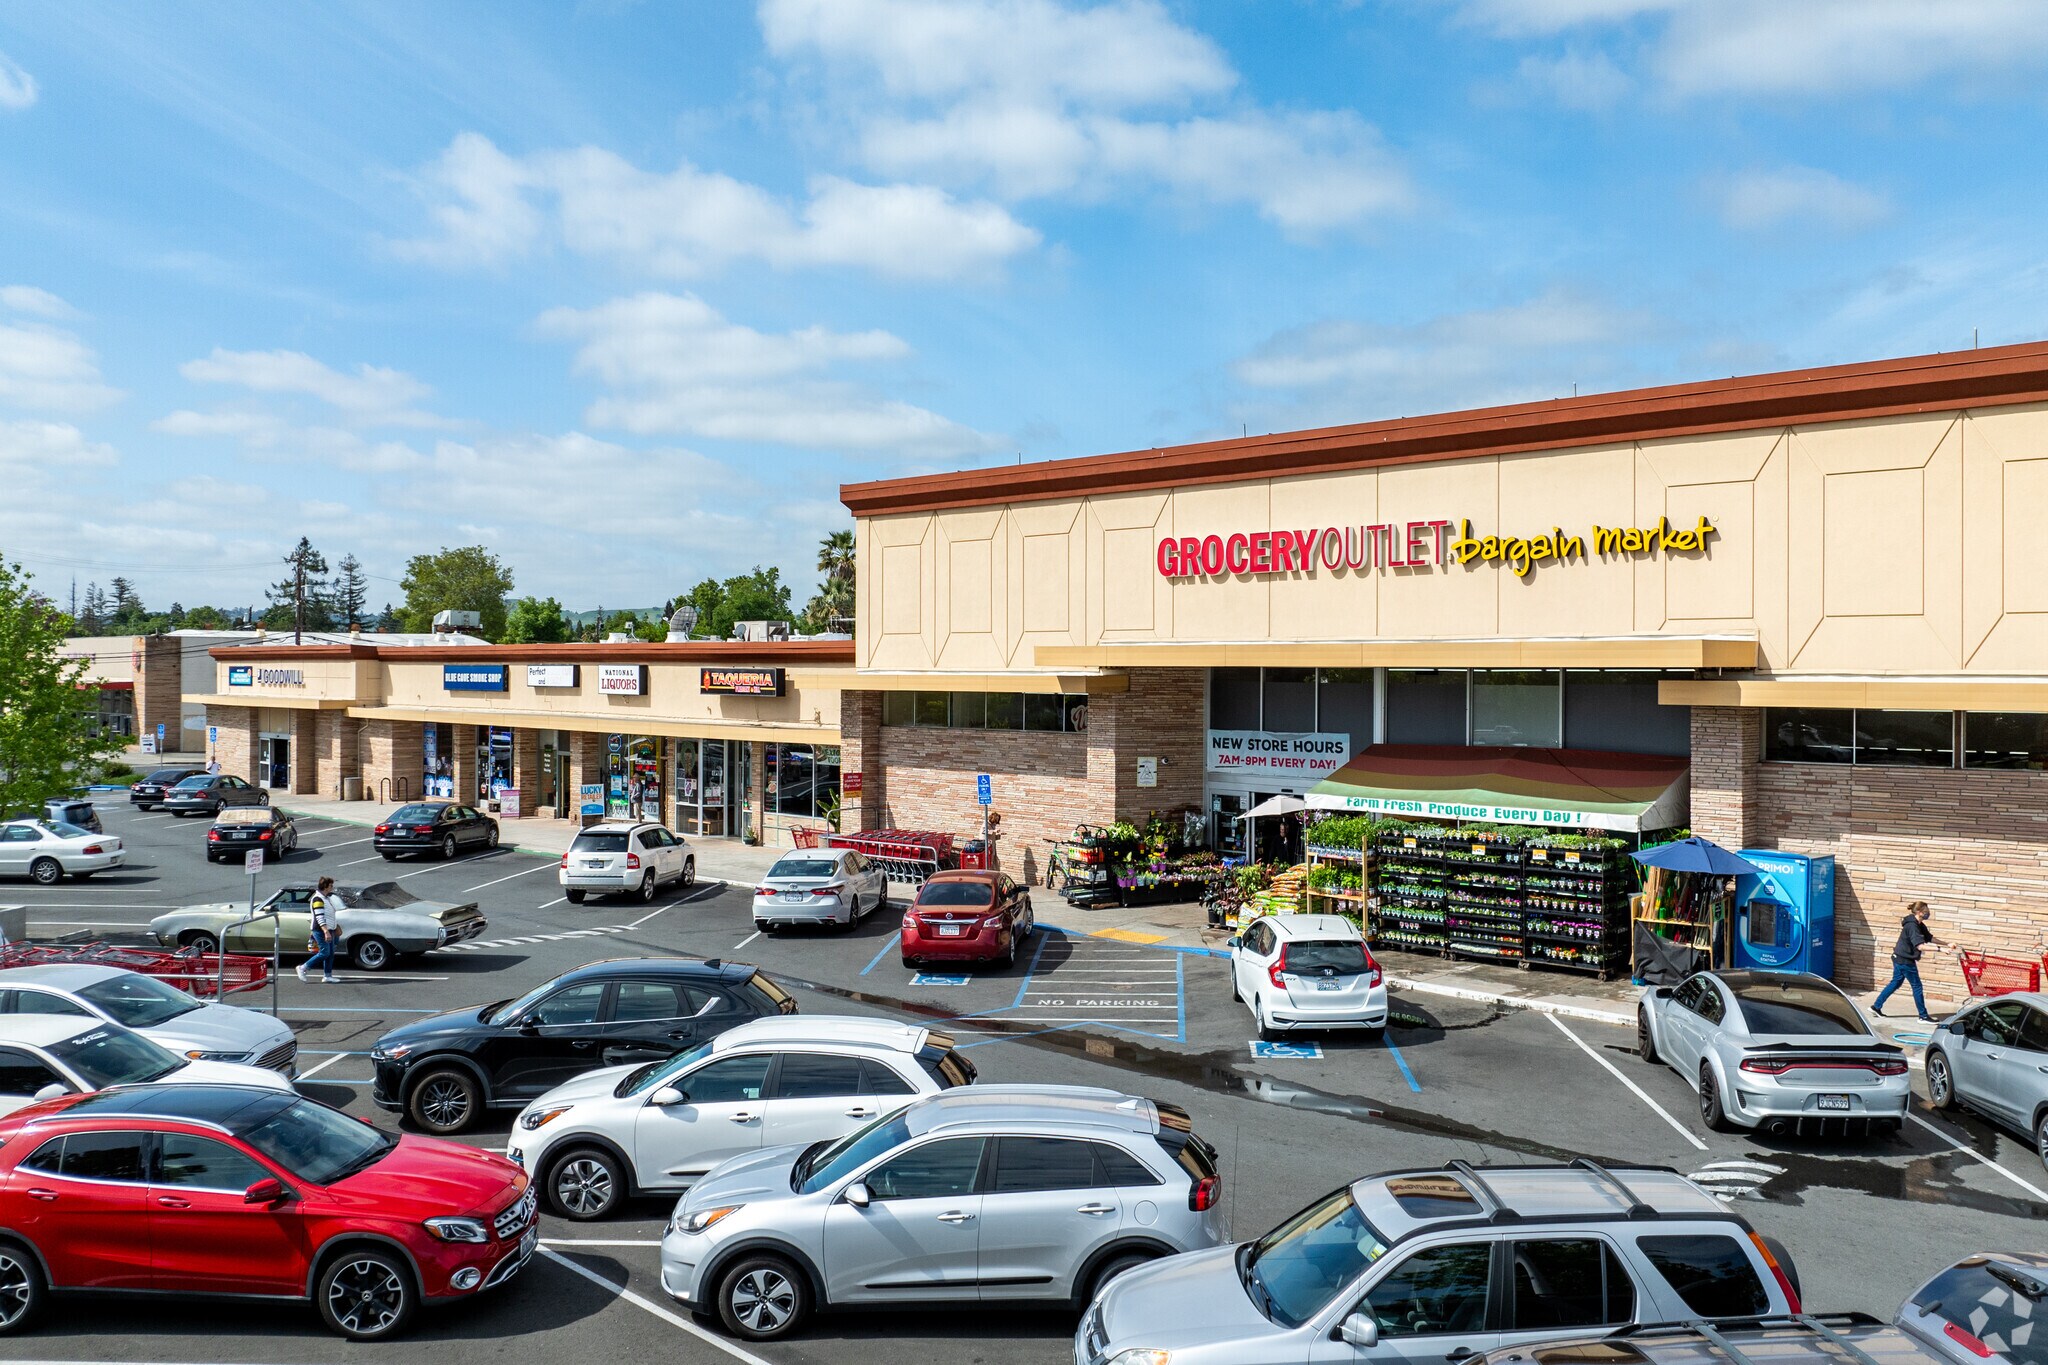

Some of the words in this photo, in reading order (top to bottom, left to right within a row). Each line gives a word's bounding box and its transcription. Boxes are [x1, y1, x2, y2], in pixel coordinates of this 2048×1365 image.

[1451, 518, 1583, 577] bargain
[1593, 515, 1714, 556] market
[263, 669, 304, 684] GOODWILL
[445, 673, 457, 682] BLUE
[488, 673, 502, 683] SHOP
[711, 672, 773, 687] TAQUERIA
[601, 678, 637, 690] LIQUORS
[1212, 737, 1243, 749] NEW
[1248, 739, 1289, 751] STORE
[1294, 741, 1344, 753] HOURS
[1218, 755, 1267, 766] 7AM-9PM
[1271, 757, 1306, 768] EVERY
[1310, 759, 1337, 769] DAY!
[581, 786, 603, 795] LUCKY
[1346, 797, 1379, 809] Farm
[1384, 799, 1422, 812] Fresh
[1429, 803, 1487, 818] Produce
[1494, 807, 1537, 821] Every
[1543, 810, 1571, 823] Day
[1758, 862, 1794, 874] PRIMO!
